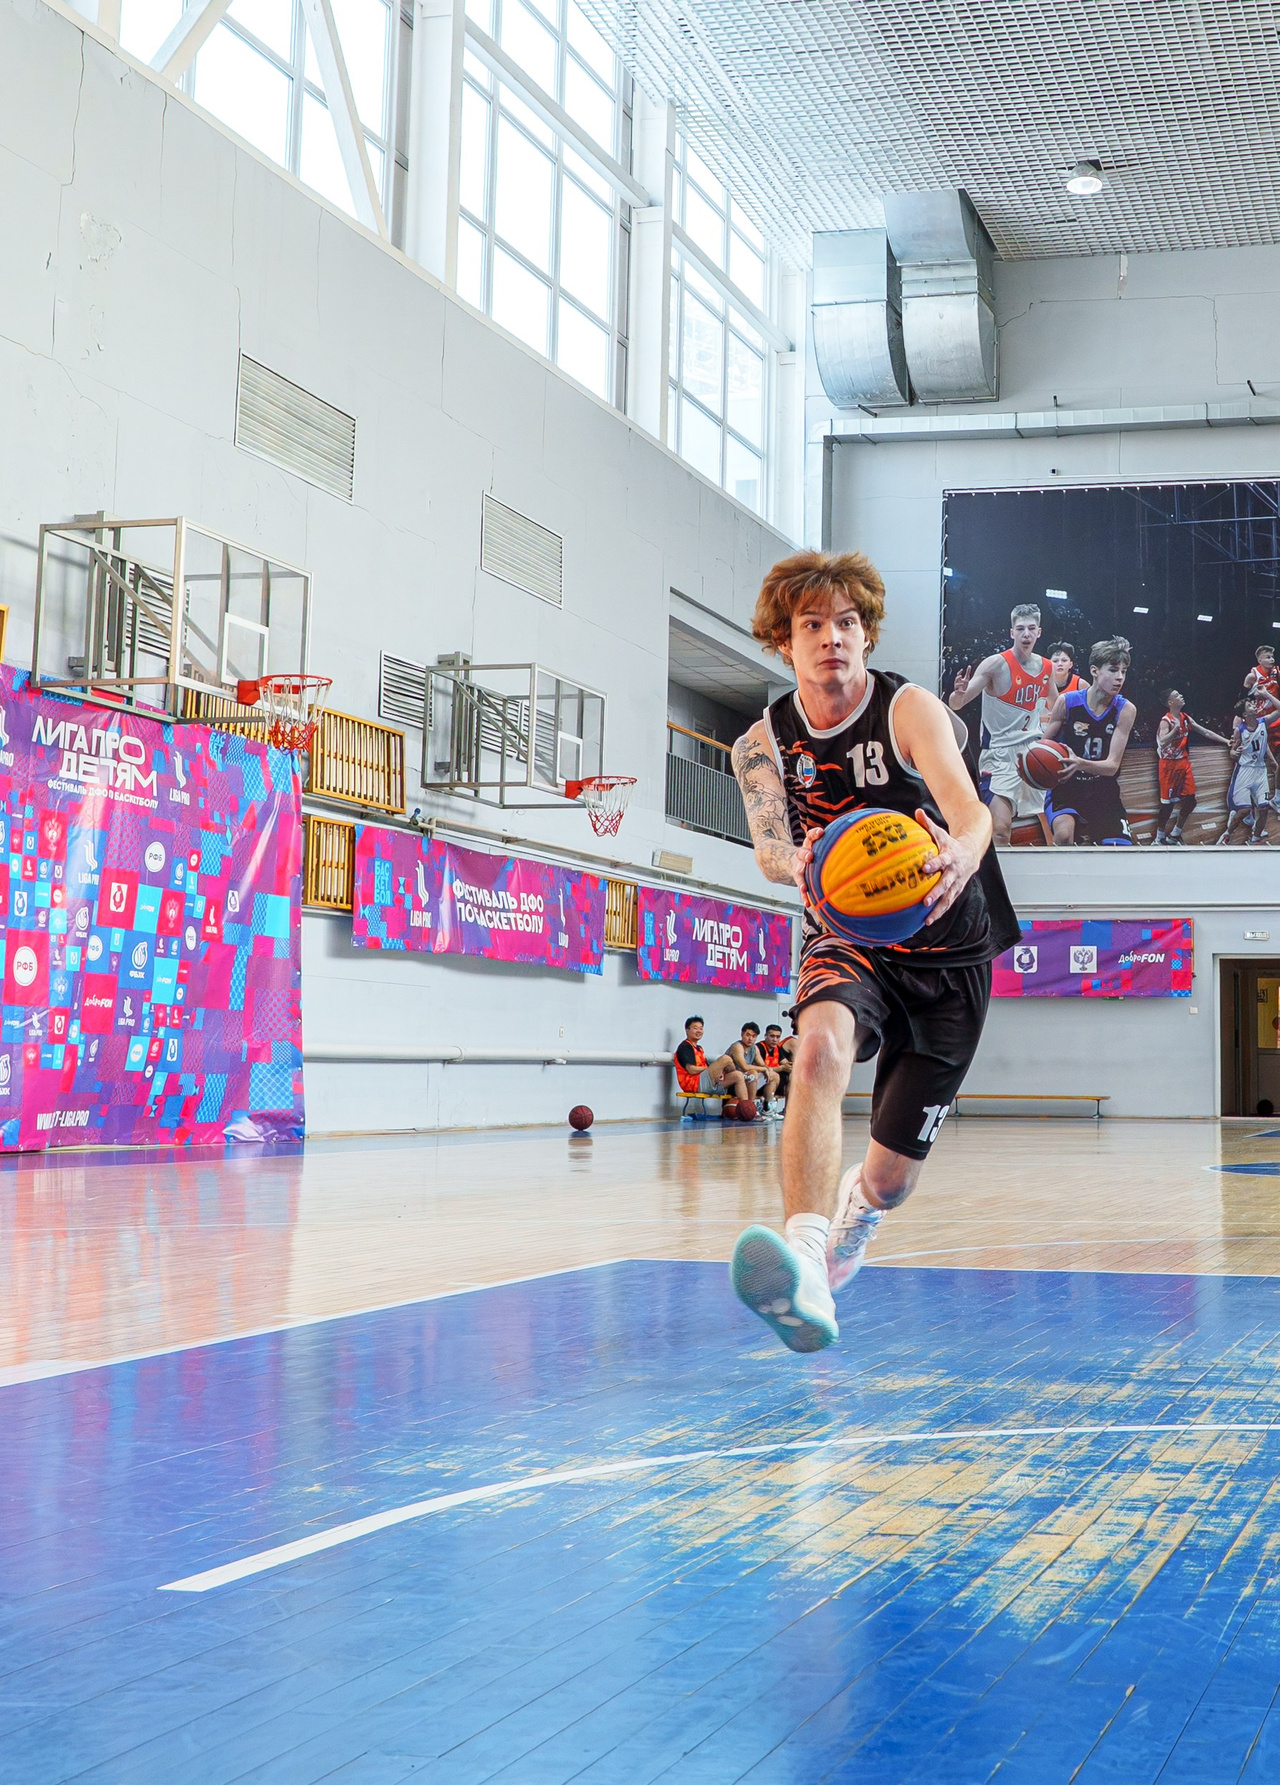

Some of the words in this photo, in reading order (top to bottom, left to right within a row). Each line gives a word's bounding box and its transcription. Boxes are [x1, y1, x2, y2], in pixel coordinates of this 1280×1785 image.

[1015, 683, 1045, 705] ЦСК
[1022, 715, 1030, 731] 2
[32, 715, 88, 753] ЛИГА
[91, 728, 146, 765] ПРО
[1083, 737, 1103, 760] 13
[846, 741, 889, 787] 13
[59, 751, 158, 797] ДЕТЯМ
[47, 779, 87, 795] ФЕСТИВАЛЬ
[149, 853, 163, 862] РФБ
[375, 861, 390, 876] БАС
[375, 876, 390, 890] КЕТ
[374, 890, 391, 905] БОЛ
[520, 892, 544, 913] ДФО
[410, 910, 422, 927] LIGA
[706, 943, 747, 973] ДЕТЯМ
[1118, 951, 1166, 963] ДоброFON
[17, 961, 33, 971] РФБ
[917, 1104, 950, 1143] 13
